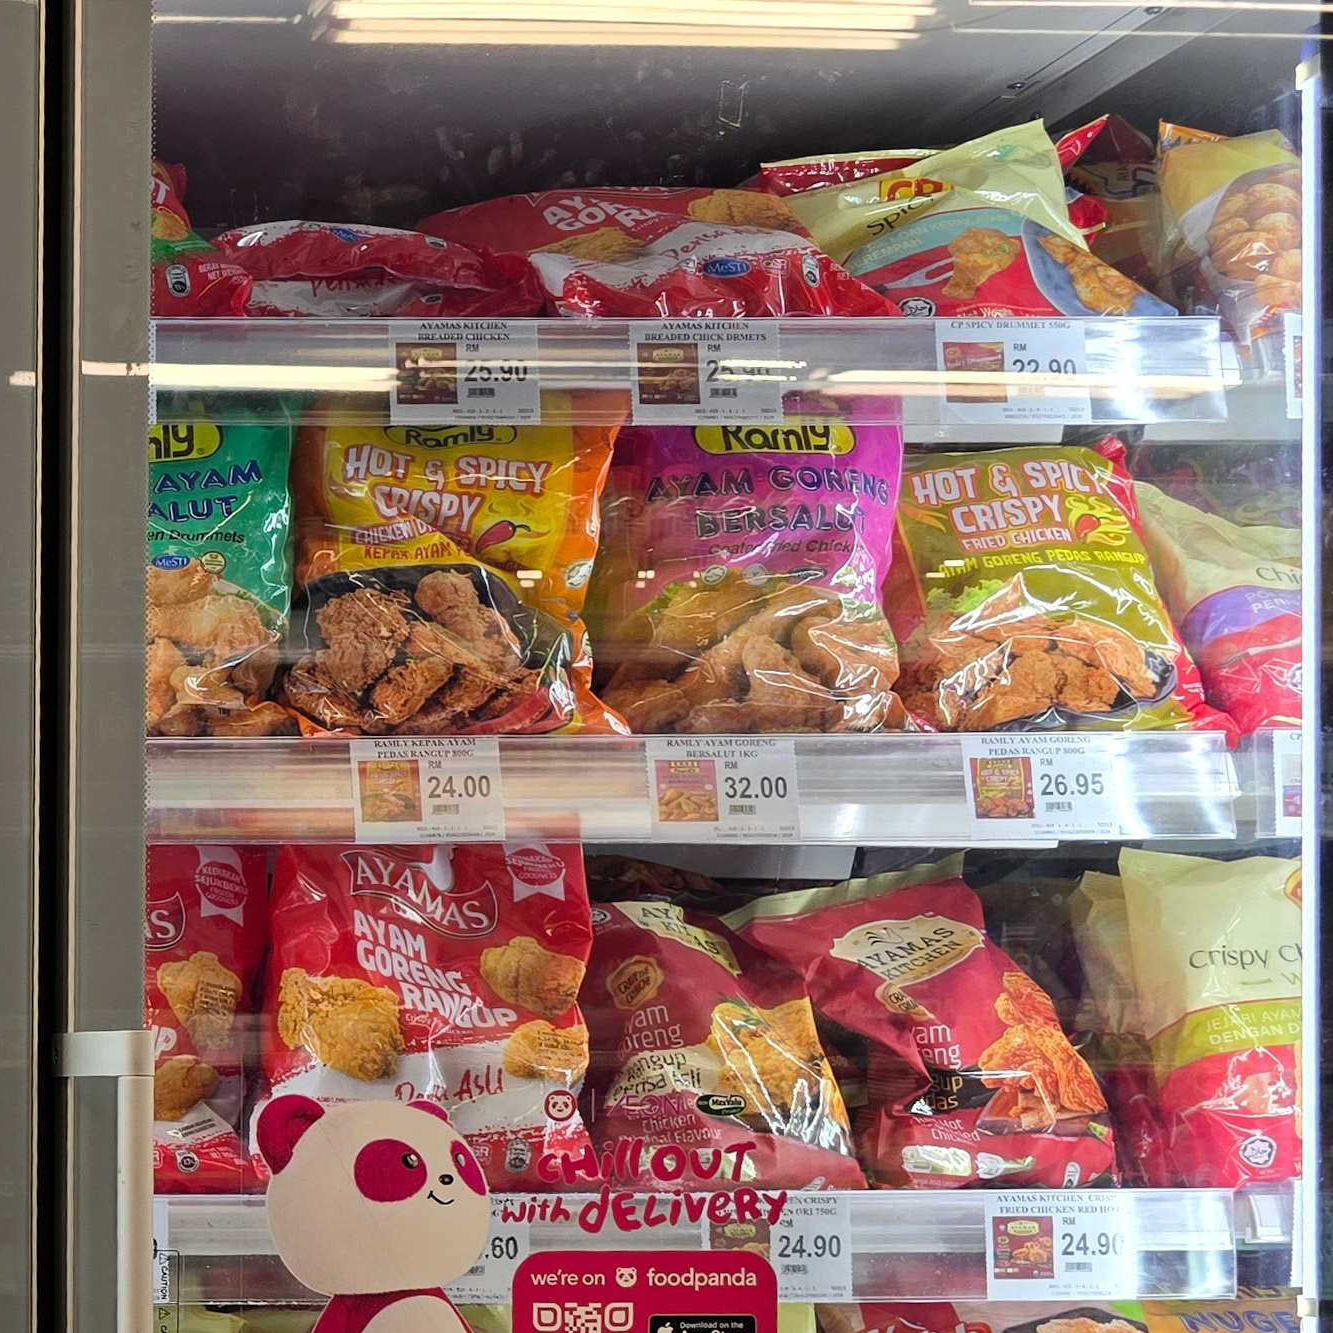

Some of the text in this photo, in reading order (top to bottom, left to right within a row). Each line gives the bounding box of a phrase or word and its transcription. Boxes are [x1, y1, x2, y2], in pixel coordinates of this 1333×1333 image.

[344, 445, 552, 493] HOT & SPICY
[952, 494, 1062, 535] CRISPY
[427, 775, 491, 799] 24.00
[723, 776, 788, 799] 32.00
[1040, 773, 1104, 797] 26.95
[353, 910, 428, 961] AYAM
[357, 940, 468, 993] GORENG
[406, 985, 517, 1029] RANGUP
[777, 1234, 841, 1259] 24.90
